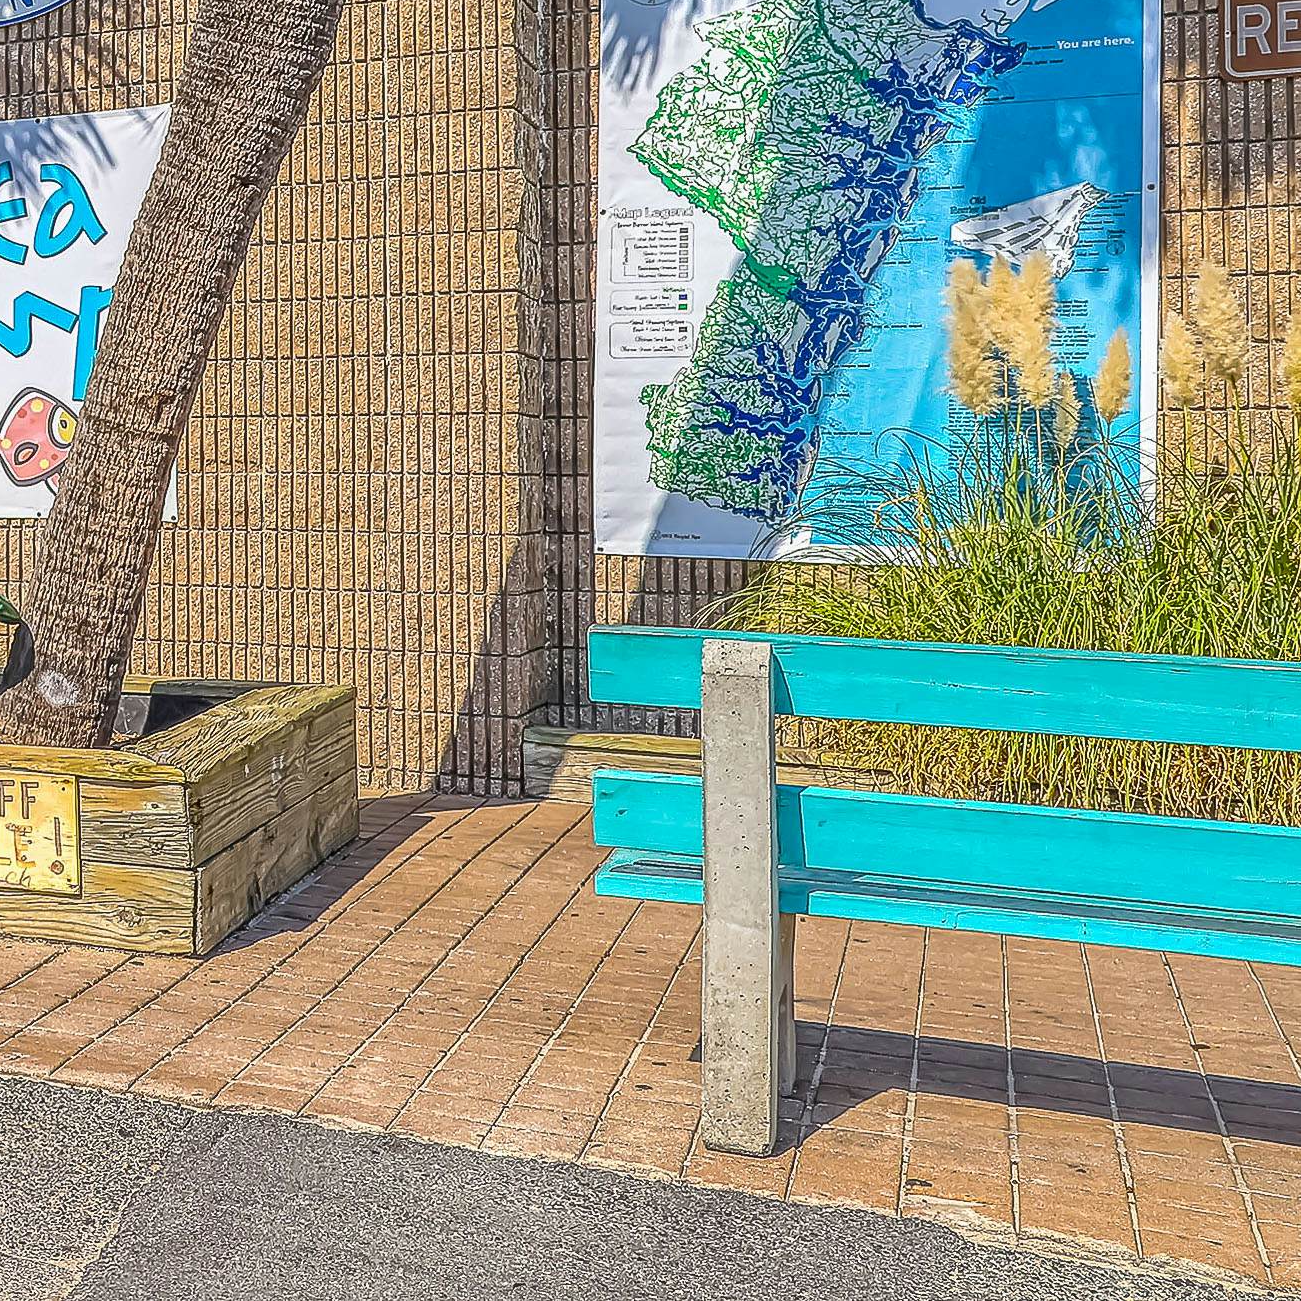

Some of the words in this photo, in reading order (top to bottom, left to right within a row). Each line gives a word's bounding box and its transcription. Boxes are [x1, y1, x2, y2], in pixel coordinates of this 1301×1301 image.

[1056, 40, 1078, 49] You
[1081, 39, 1100, 47] are
[1103, 37, 1134, 46] here.
